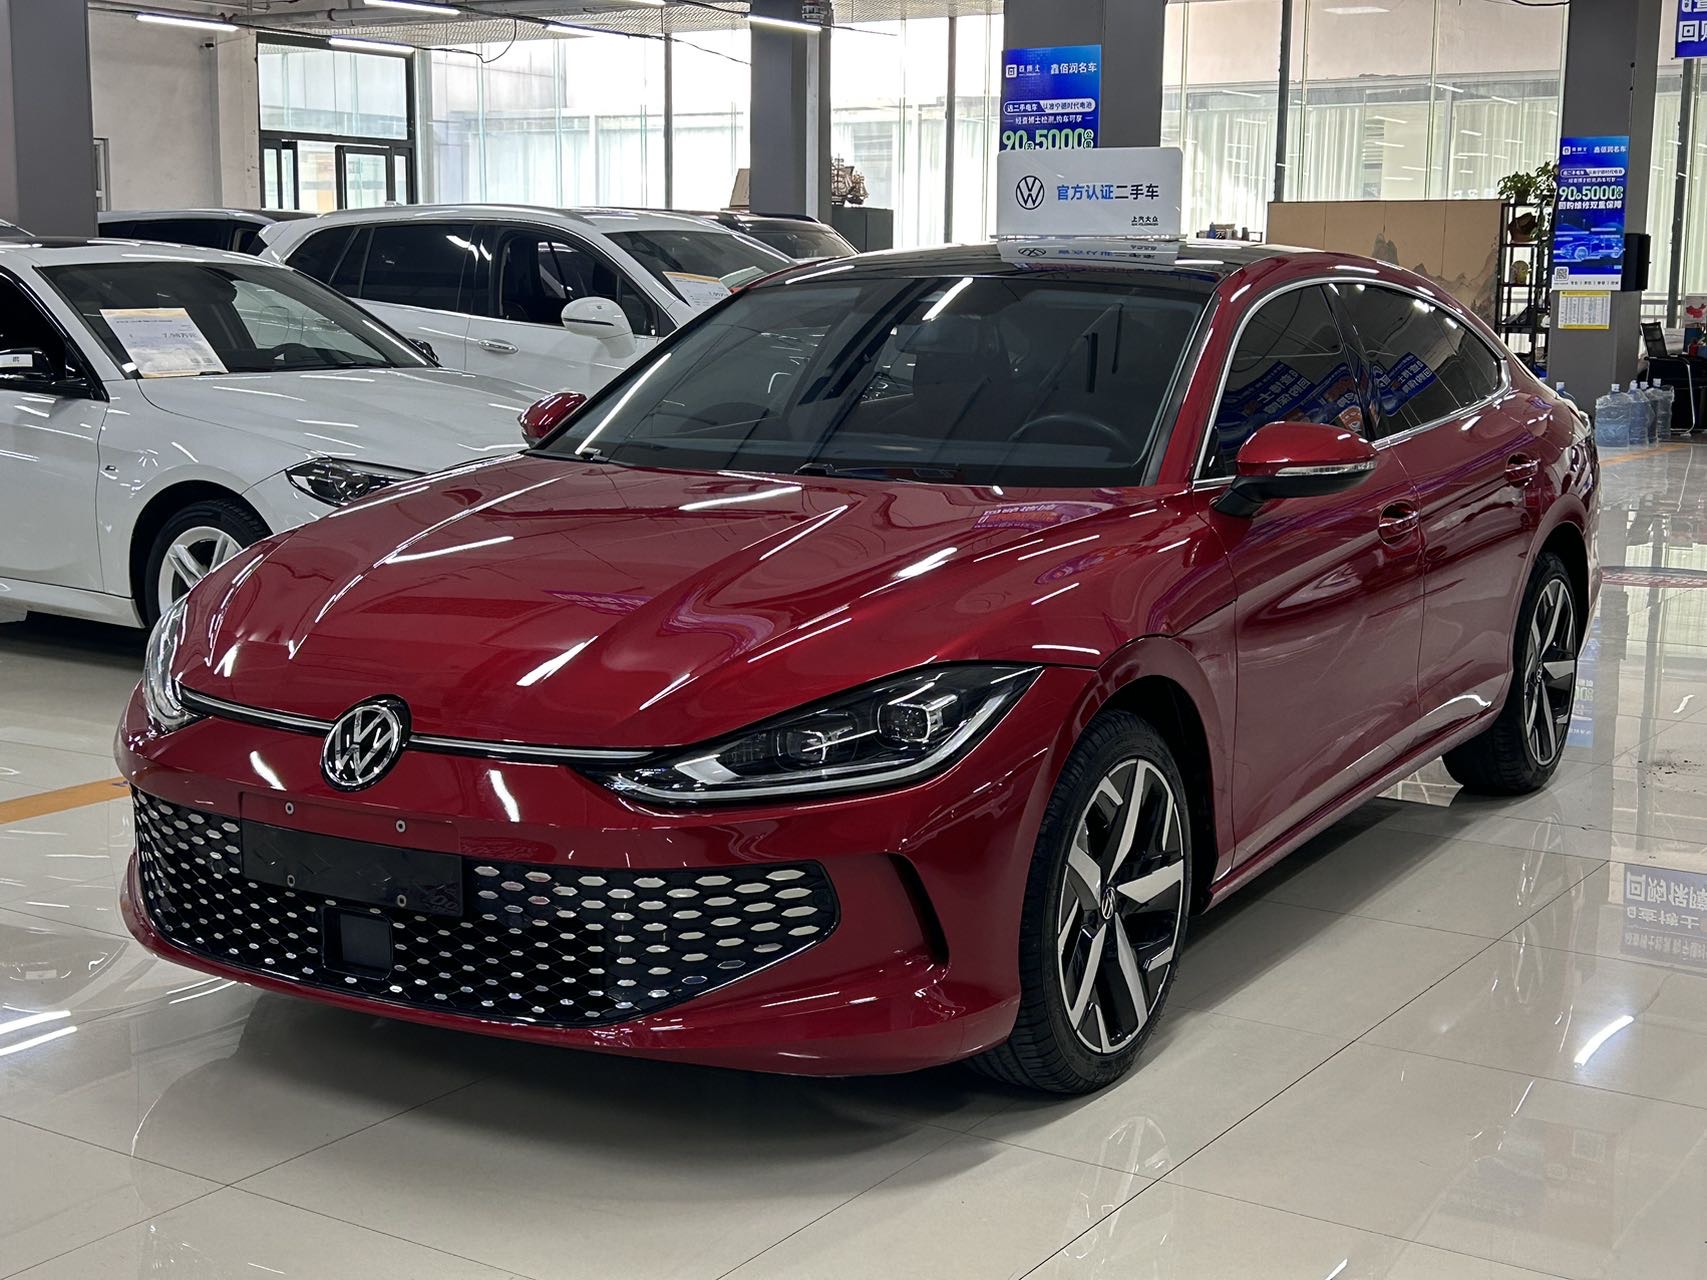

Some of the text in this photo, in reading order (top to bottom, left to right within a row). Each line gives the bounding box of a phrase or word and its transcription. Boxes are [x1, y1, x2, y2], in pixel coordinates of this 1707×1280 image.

[1050, 62, 1098, 75] 鑫佰润名车
[1056, 183, 1160, 201] 官方认证二手车
[1131, 215, 1159, 223] 上汽大众
